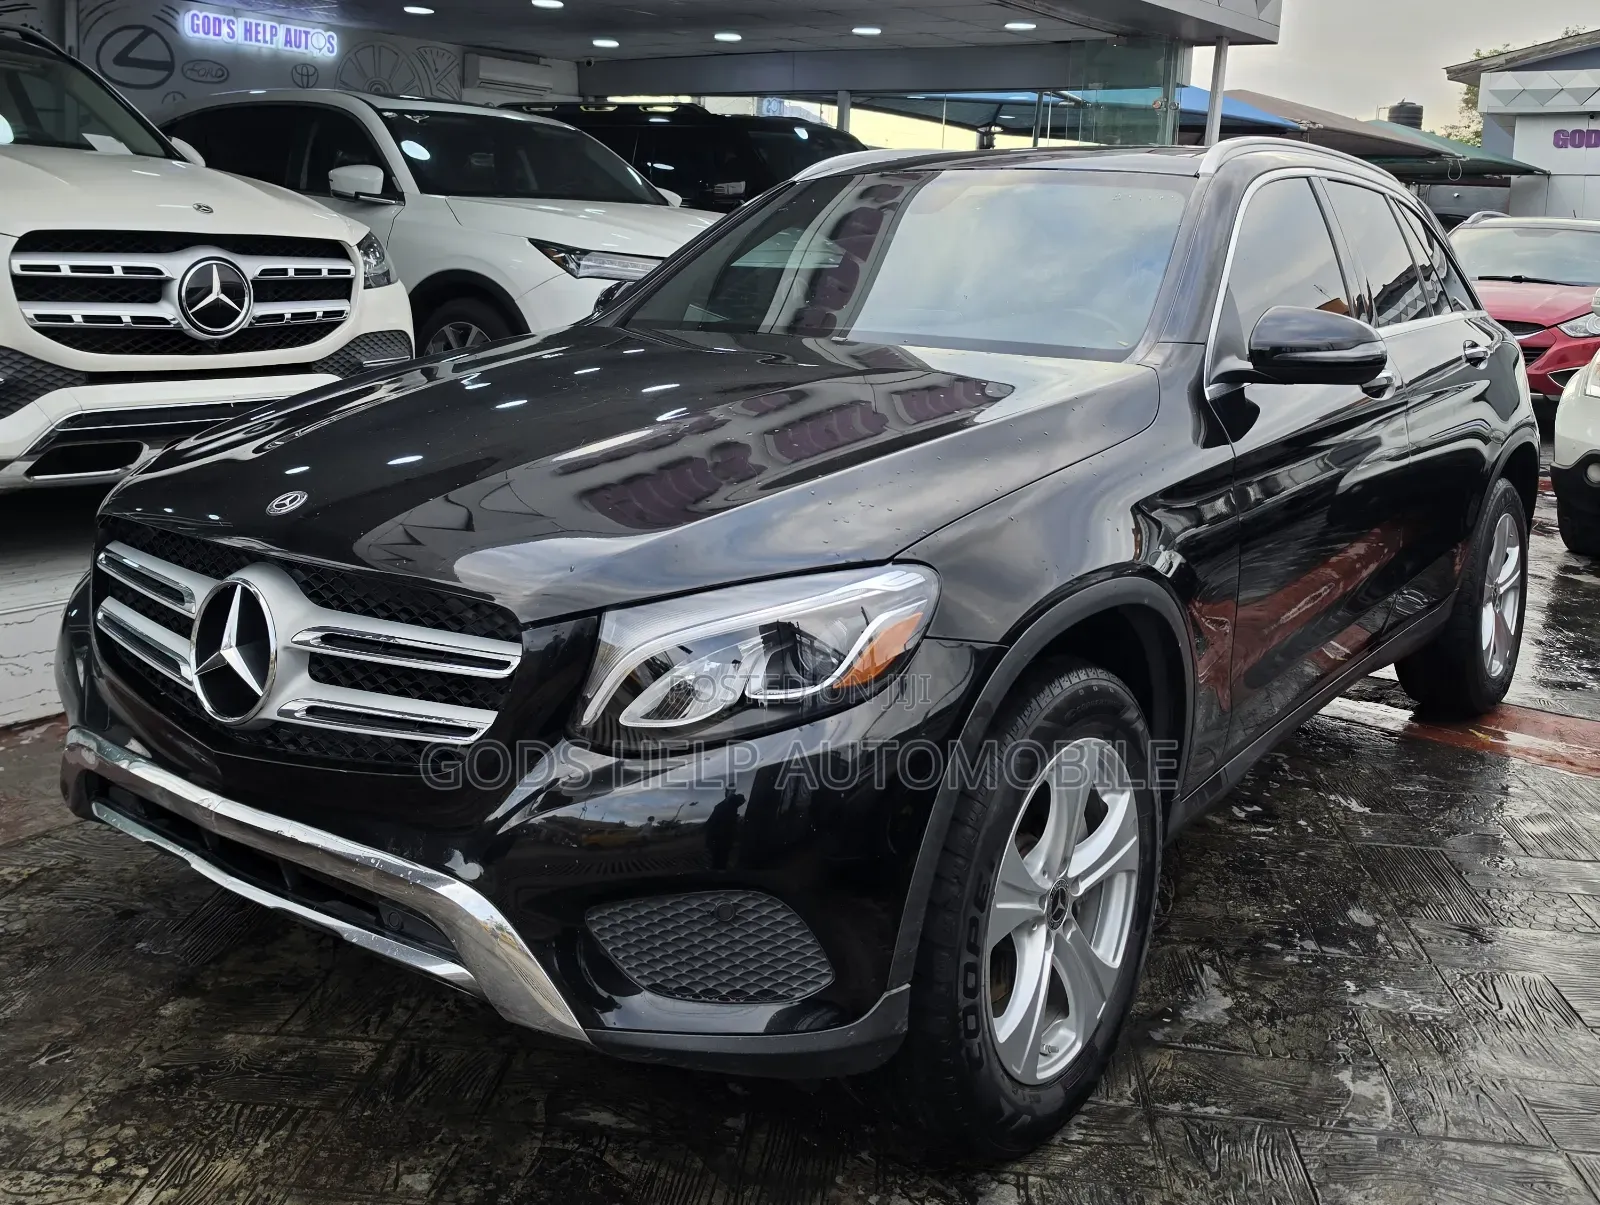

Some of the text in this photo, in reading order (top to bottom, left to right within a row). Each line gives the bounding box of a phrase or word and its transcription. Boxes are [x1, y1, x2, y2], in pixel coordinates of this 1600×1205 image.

[190, 12, 336, 54] GOD'S HELP AUTOS
[1553, 128, 1600, 149] GOD
